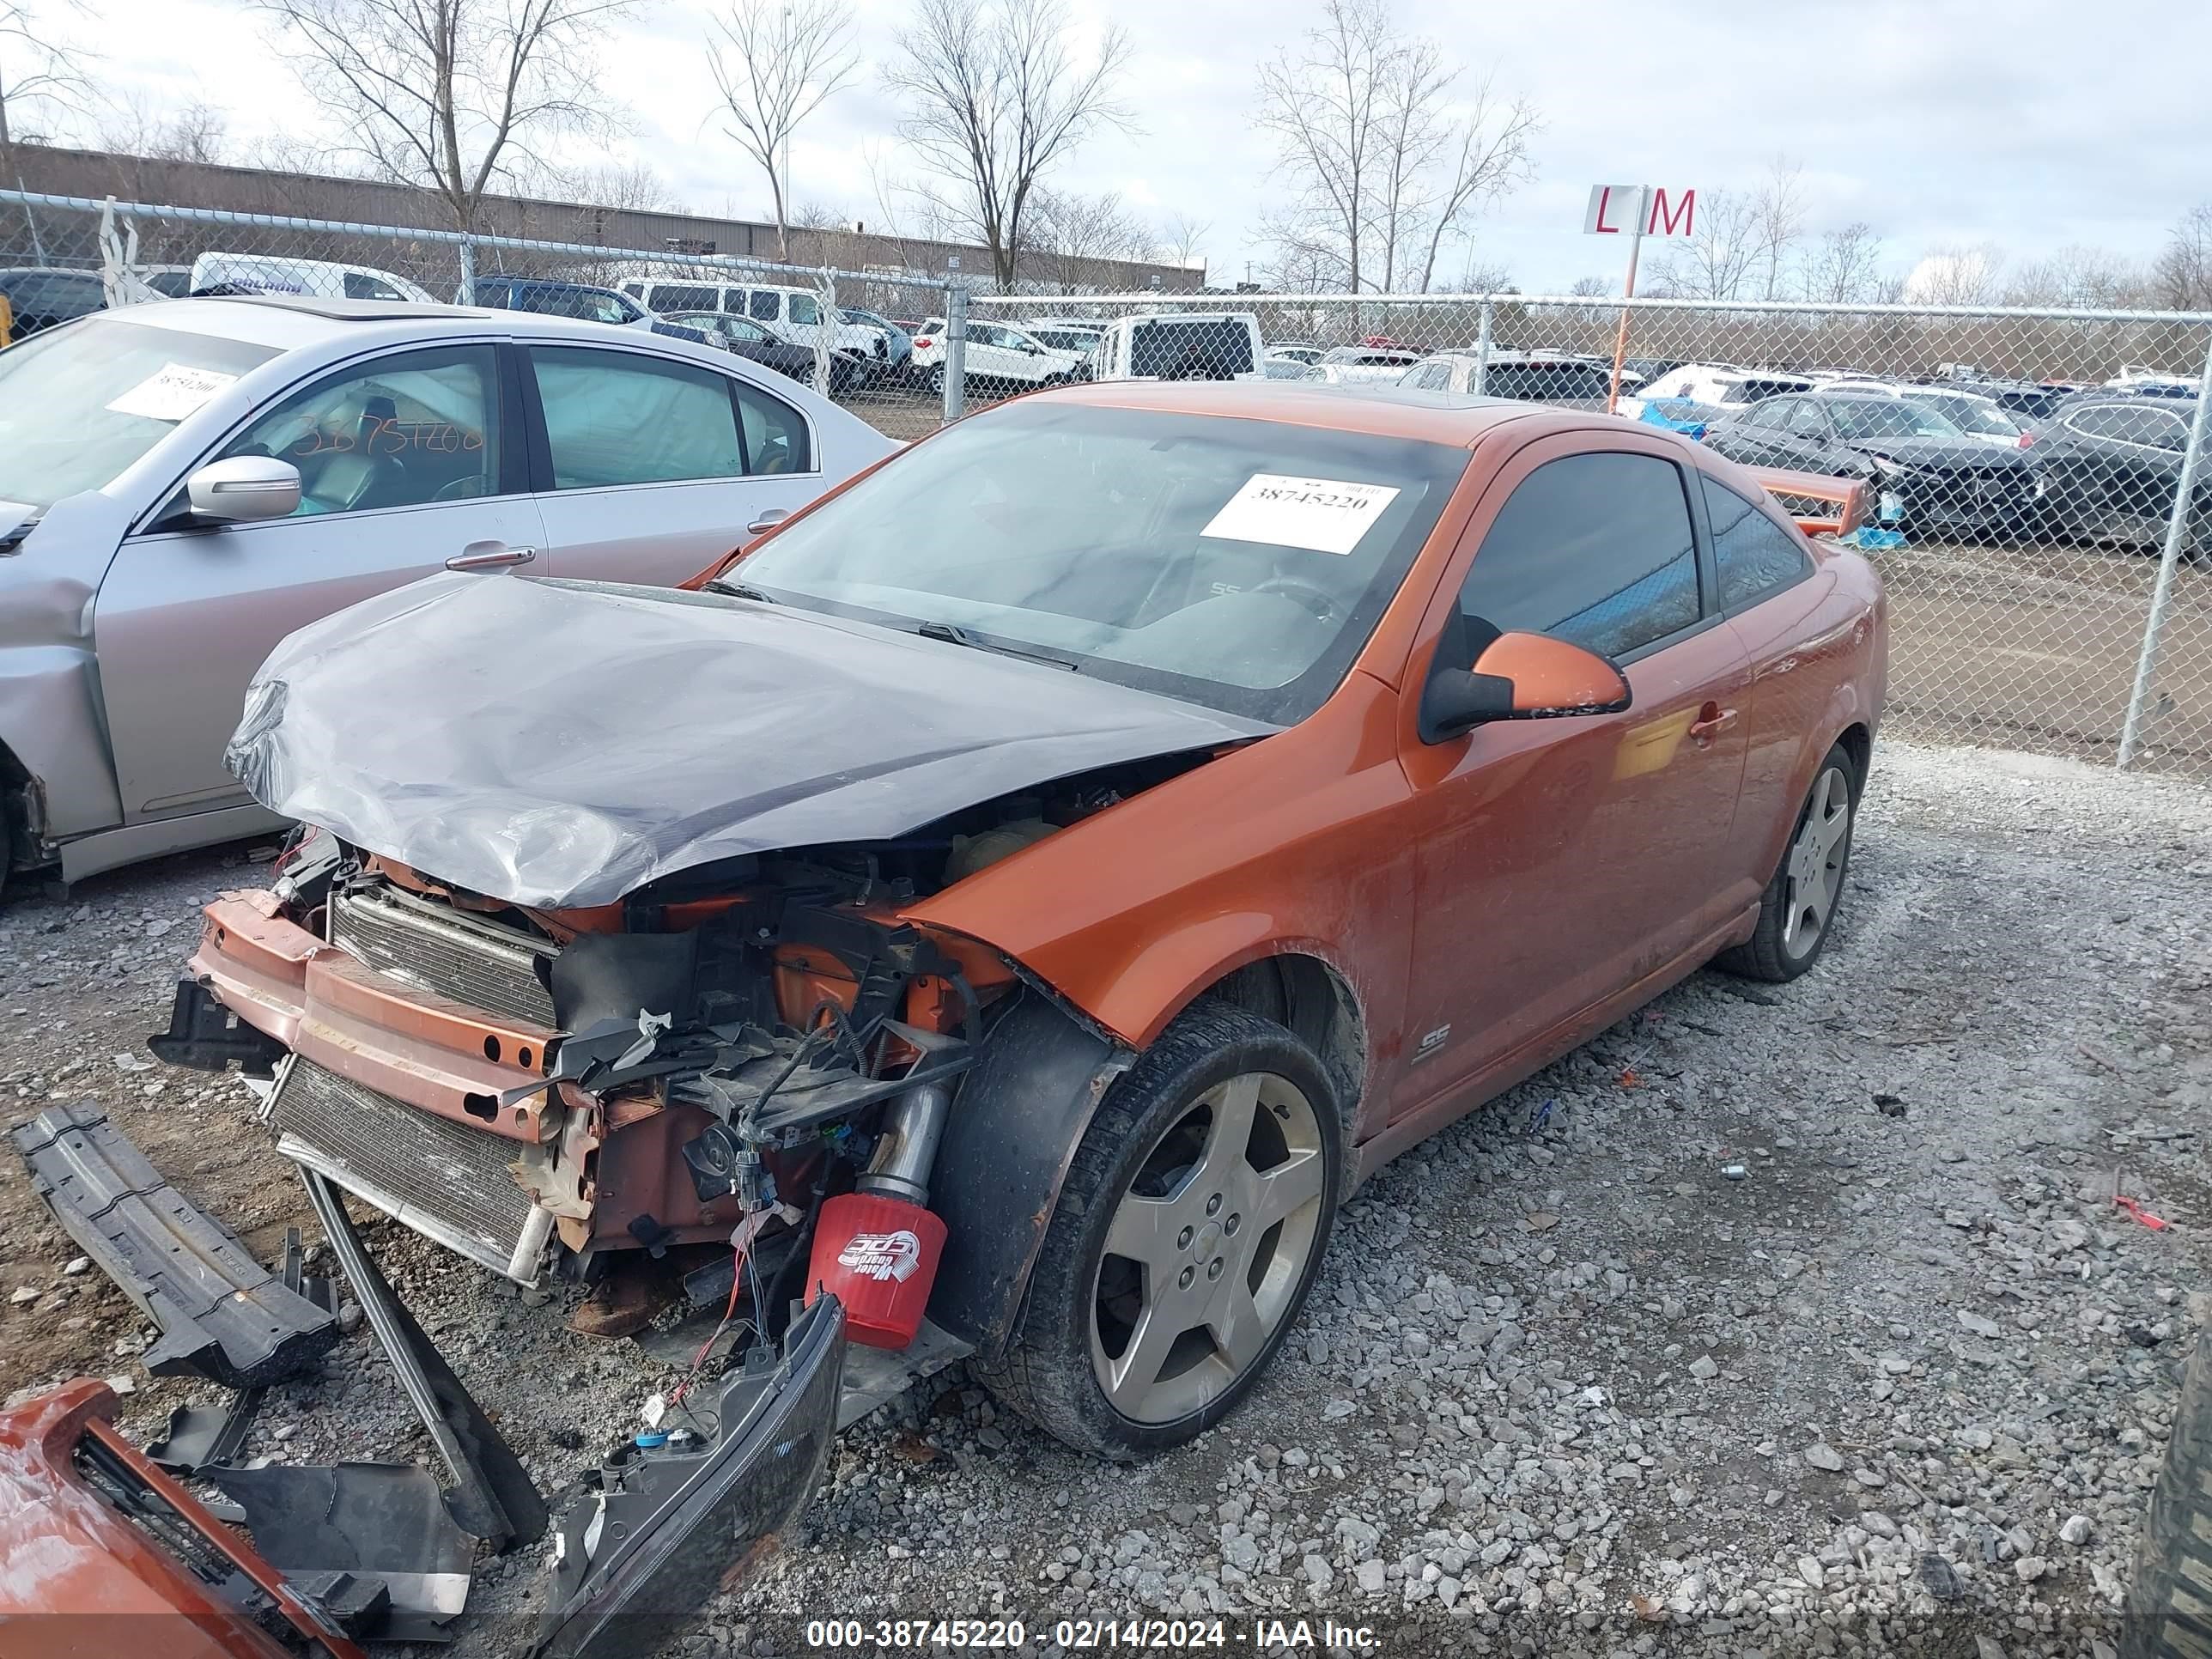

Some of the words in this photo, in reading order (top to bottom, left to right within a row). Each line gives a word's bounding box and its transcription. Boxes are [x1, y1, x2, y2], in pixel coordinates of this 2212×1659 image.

[1596, 186, 1619, 233] L
[1649, 188, 1695, 236] M
[1250, 488, 1370, 511] 38745220
[854, 1264, 894, 1281] Water
